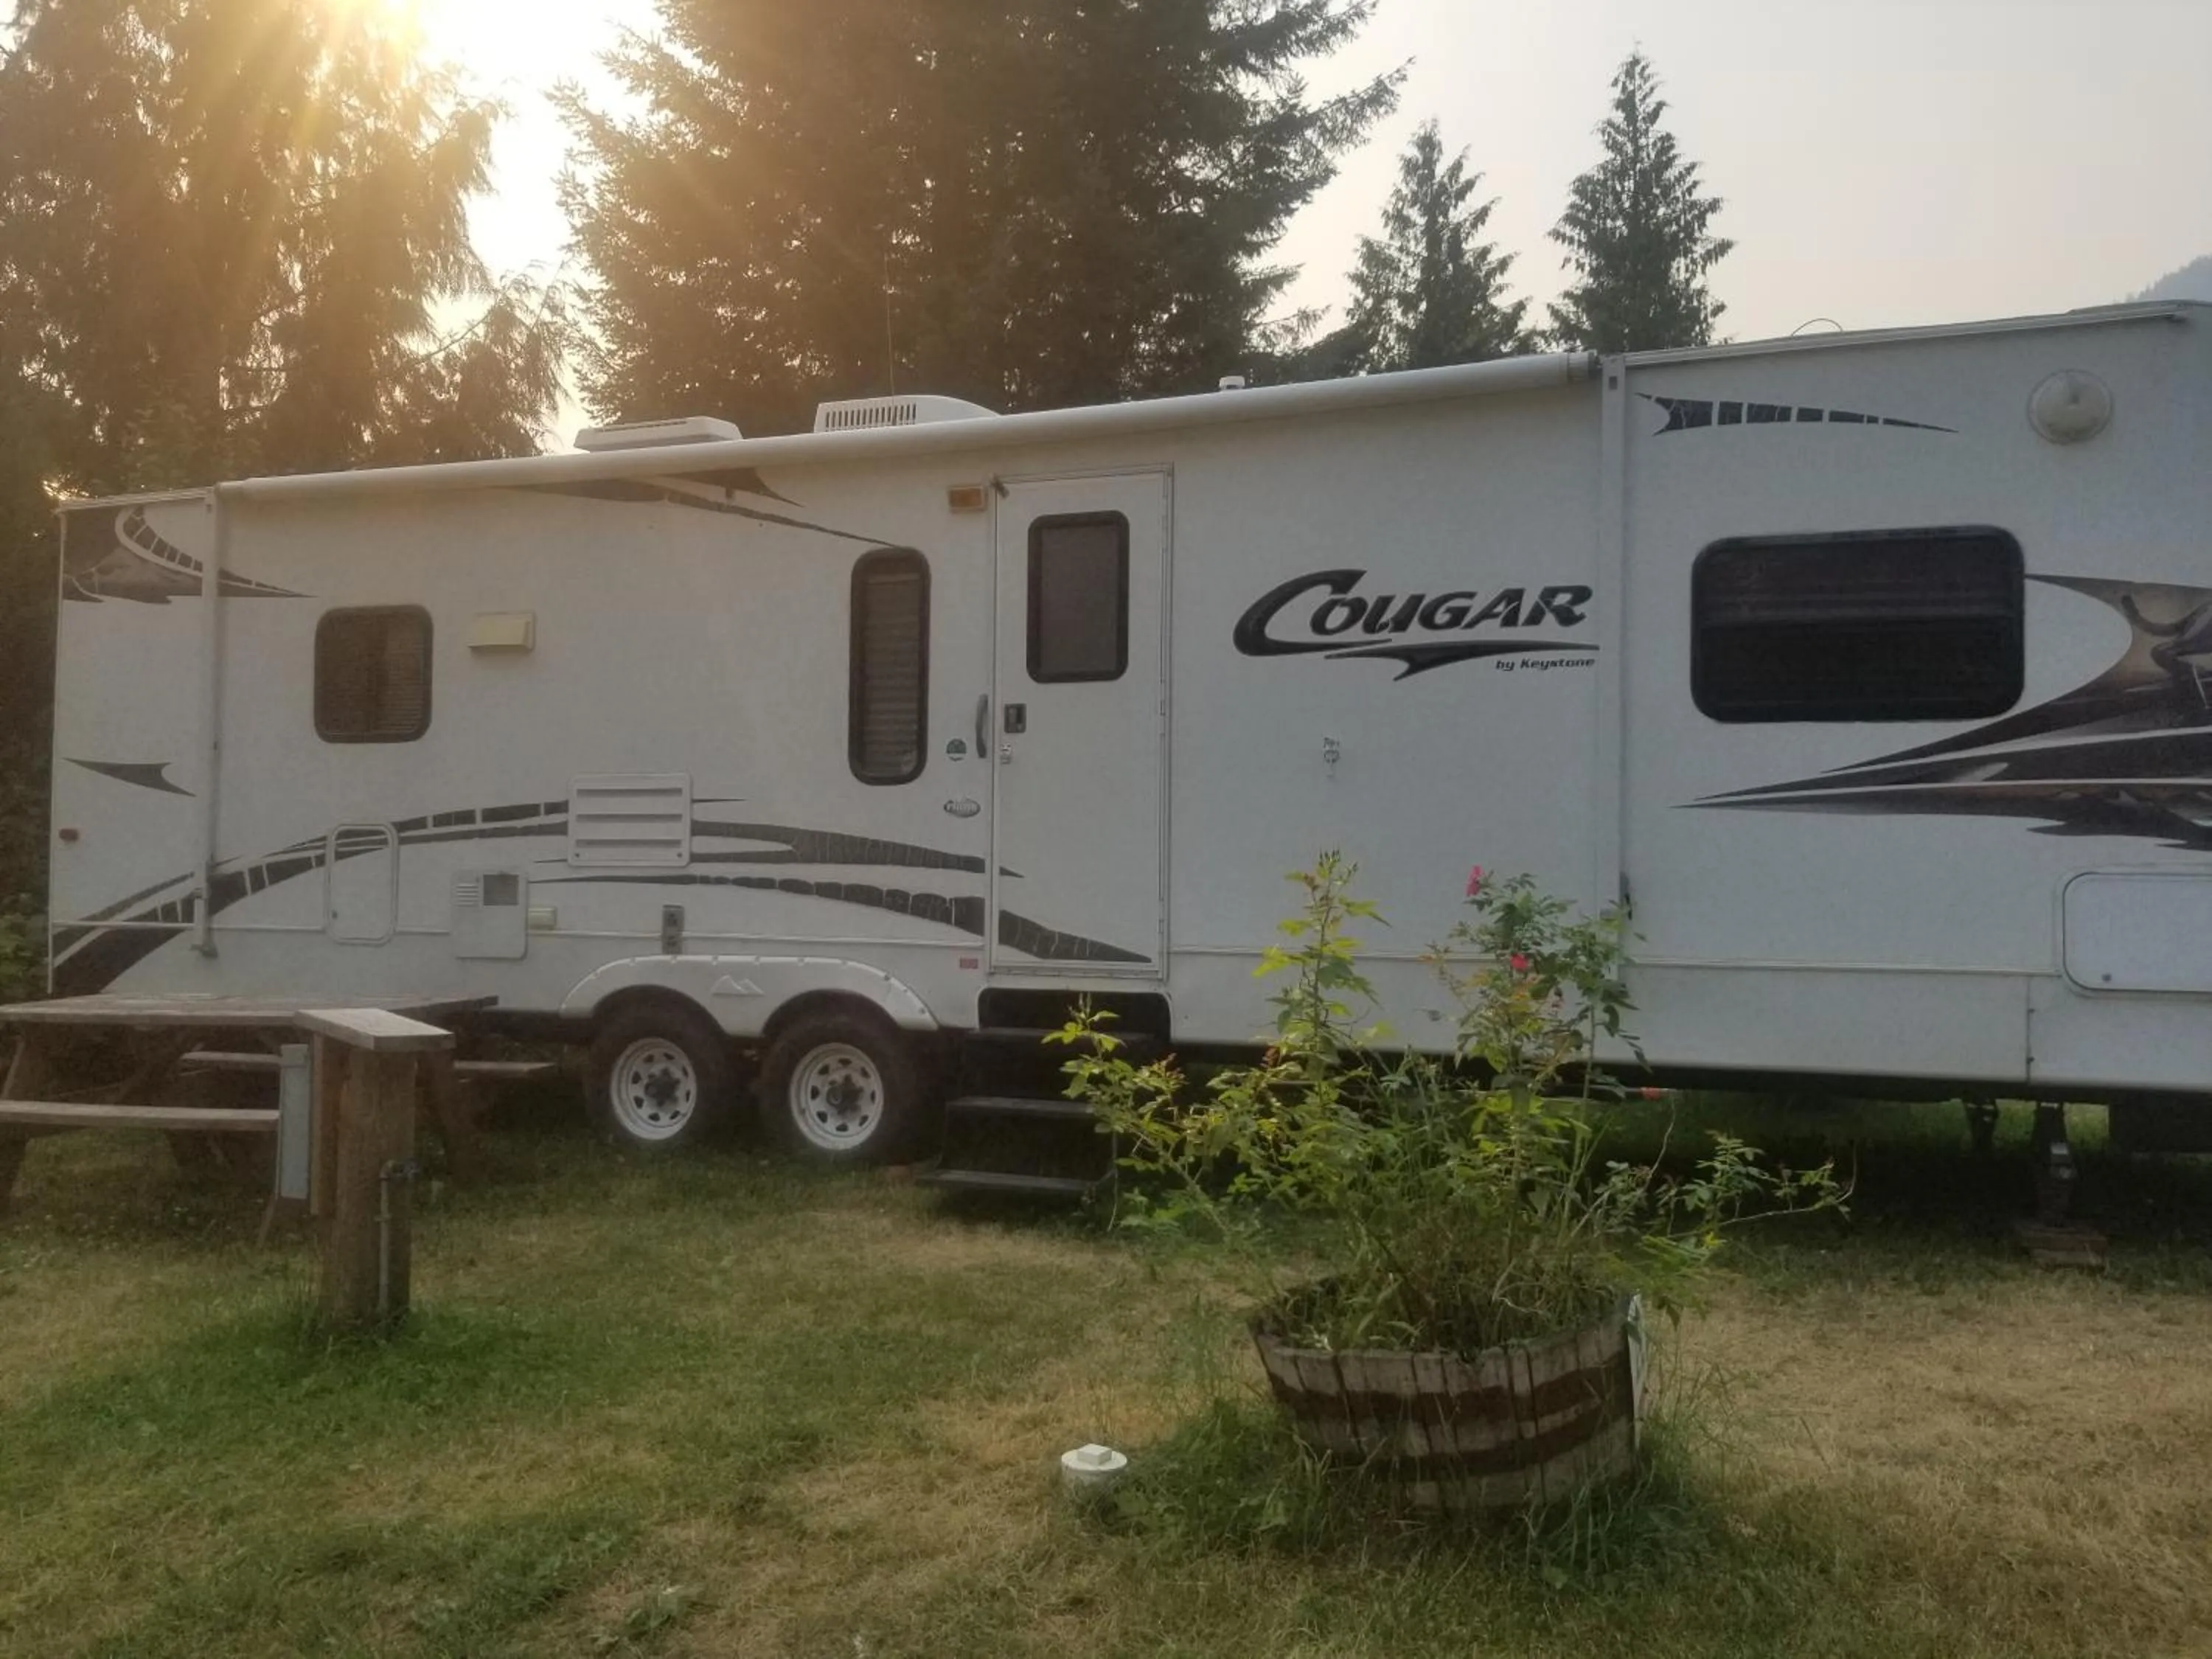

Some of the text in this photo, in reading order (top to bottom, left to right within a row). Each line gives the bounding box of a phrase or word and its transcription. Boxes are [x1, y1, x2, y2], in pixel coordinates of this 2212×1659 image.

[1233, 569, 1593, 656] COUGAR
[1495, 658, 1595, 672] by Keystone
